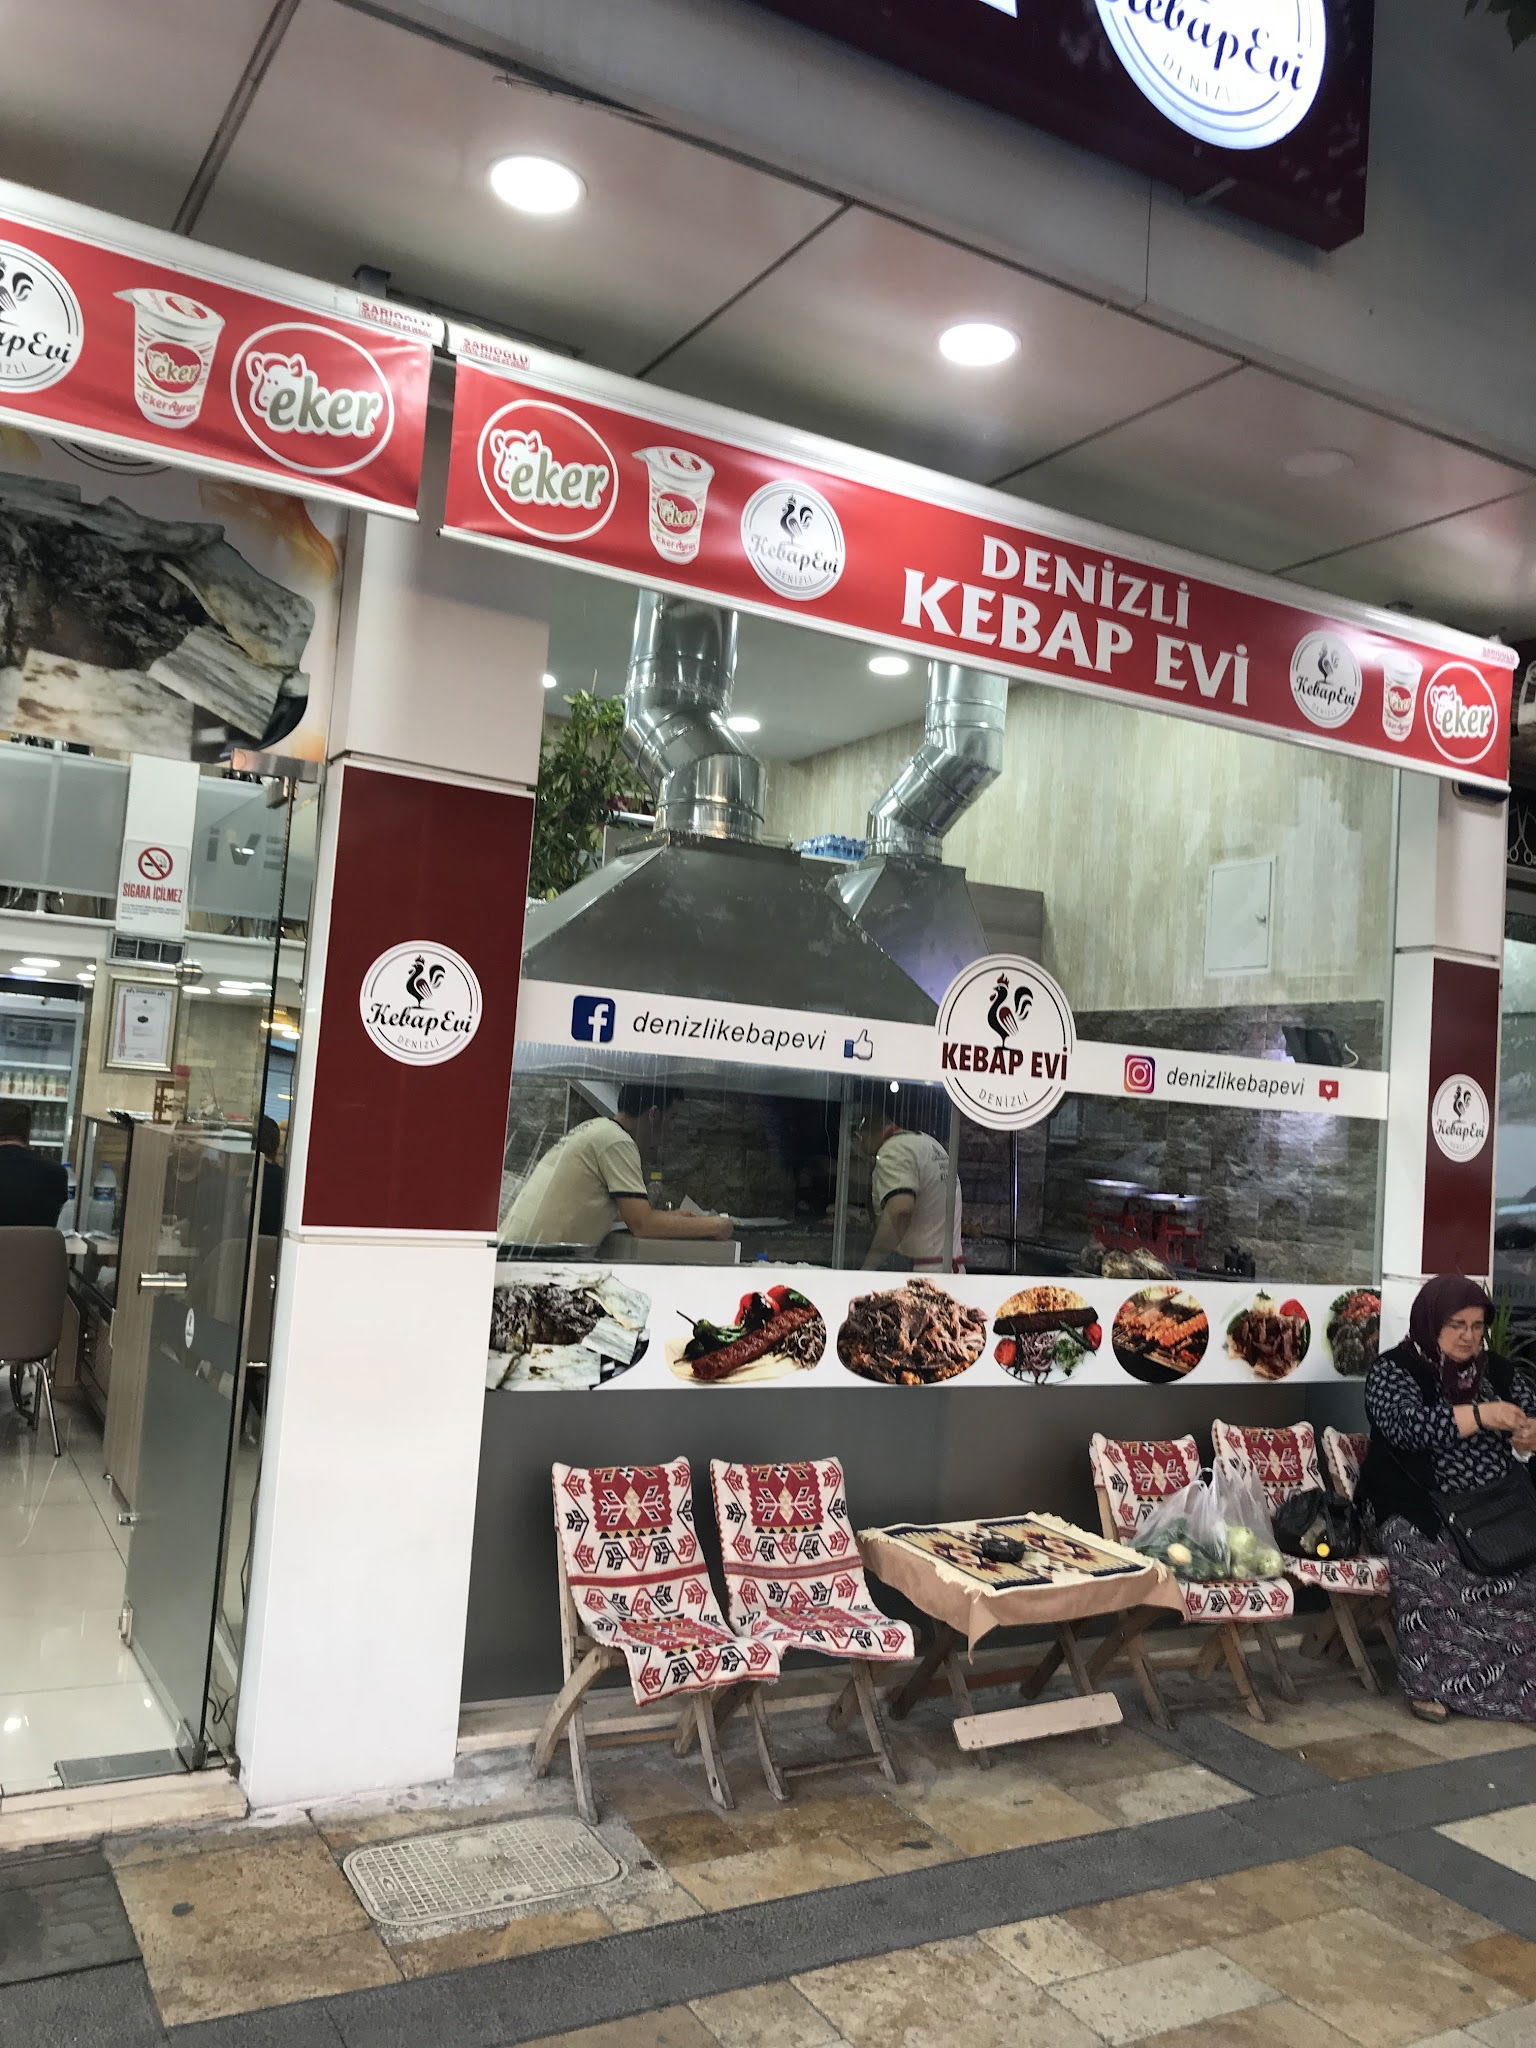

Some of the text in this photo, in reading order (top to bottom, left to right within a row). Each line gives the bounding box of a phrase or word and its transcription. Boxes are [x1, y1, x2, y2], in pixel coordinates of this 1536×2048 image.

[1108, 0, 1303, 91] ebapEvi
[155, 361, 198, 381] eker
[268, 376, 380, 433] eker
[510, 451, 607, 504] eker
[981, 534, 1191, 630] DENİZLİ
[900, 567, 1250, 707] KEBAP EVİ
[1441, 702, 1490, 735] eker
[122, 882, 150, 900] SİGARA
[632, 1011, 827, 1052] denizlikebapevi
[941, 1042, 1068, 1081] KEBAP EVİ
[1166, 1066, 1305, 1099] denizlikebapevi
